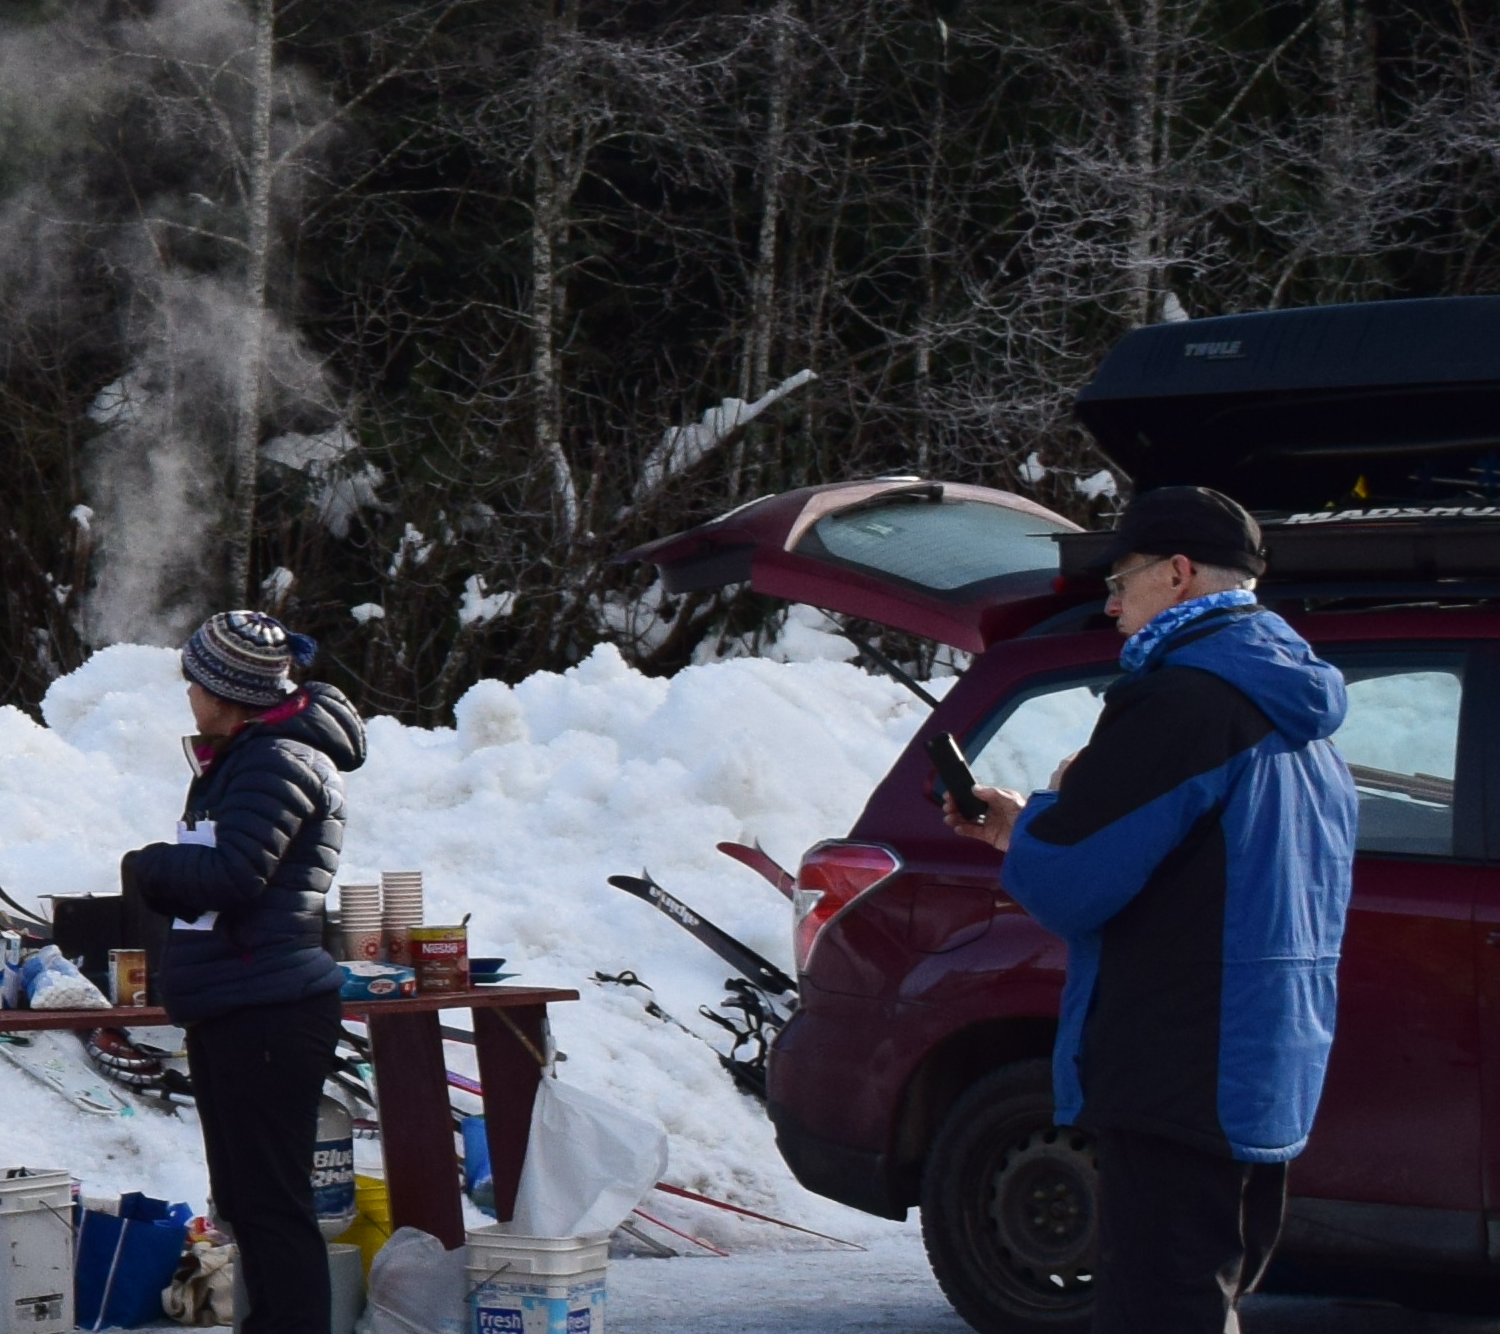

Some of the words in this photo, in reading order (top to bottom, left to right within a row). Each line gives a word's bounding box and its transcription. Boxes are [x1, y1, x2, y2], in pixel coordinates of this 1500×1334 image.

[1184, 340, 1242, 357] THULE
[1284, 505, 1500, 525] MADSHU
[480, 1312, 521, 1328] Fresh
